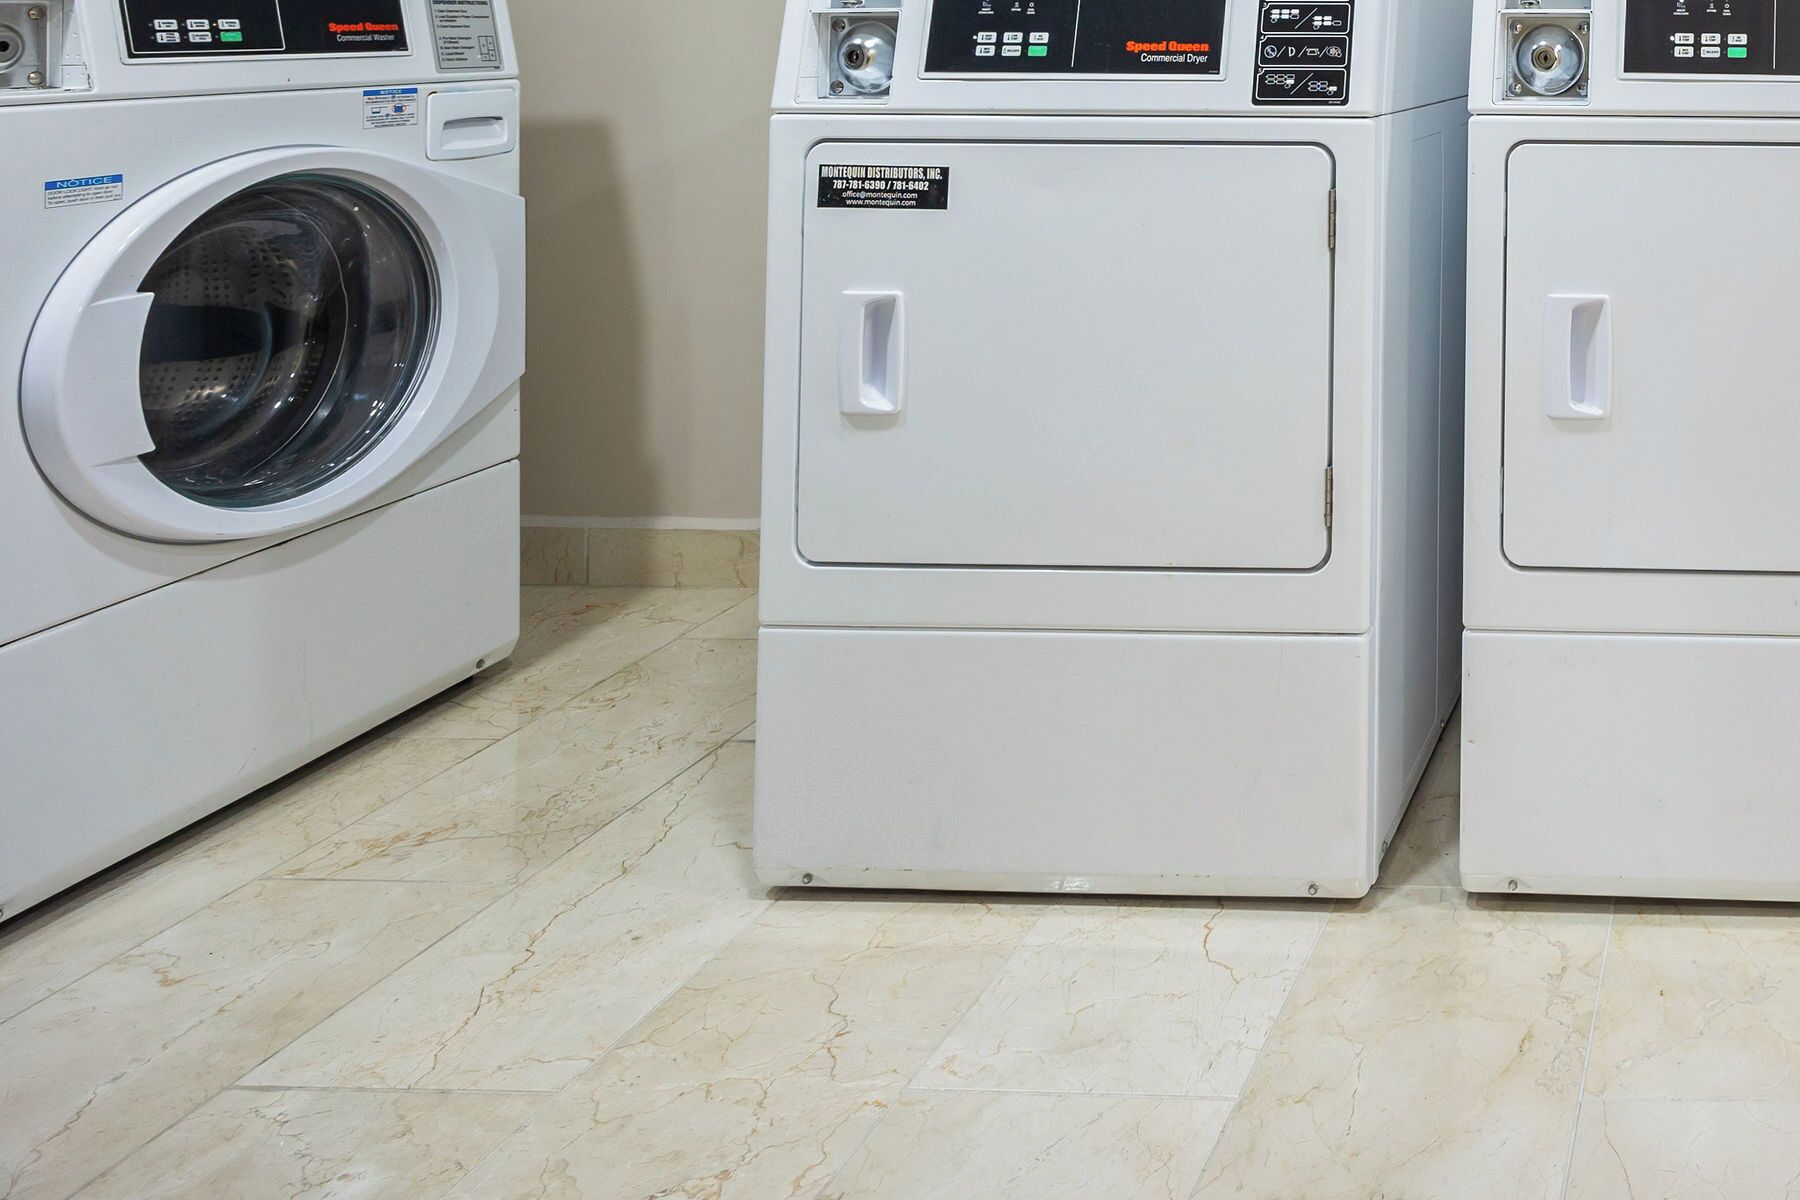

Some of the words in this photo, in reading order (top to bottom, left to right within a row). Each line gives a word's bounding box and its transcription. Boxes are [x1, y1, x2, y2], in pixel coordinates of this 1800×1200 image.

[328, 22, 364, 33] Speed
[365, 23, 399, 32] Queen
[336, 34, 372, 42] Commercial
[373, 34, 395, 42] Washer
[1126, 40, 1167, 53] Speed
[1168, 41, 1210, 52] Queen
[1140, 53, 1186, 63] Commercial
[1187, 53, 1208, 64] Dryer
[821, 166, 866, 179] MONTEQUIN
[867, 167, 926, 181] DISTRIBUTORS,
[927, 168, 943, 180] INC.
[56, 176, 113, 188] NOTICE
[832, 180, 885, 190] 787-781-6390
[886, 181, 891, 190] /
[892, 181, 929, 191] 781-6402
[842, 191, 918, 199] office@montequin.com
[845, 199, 916, 207] www.montequin.com
